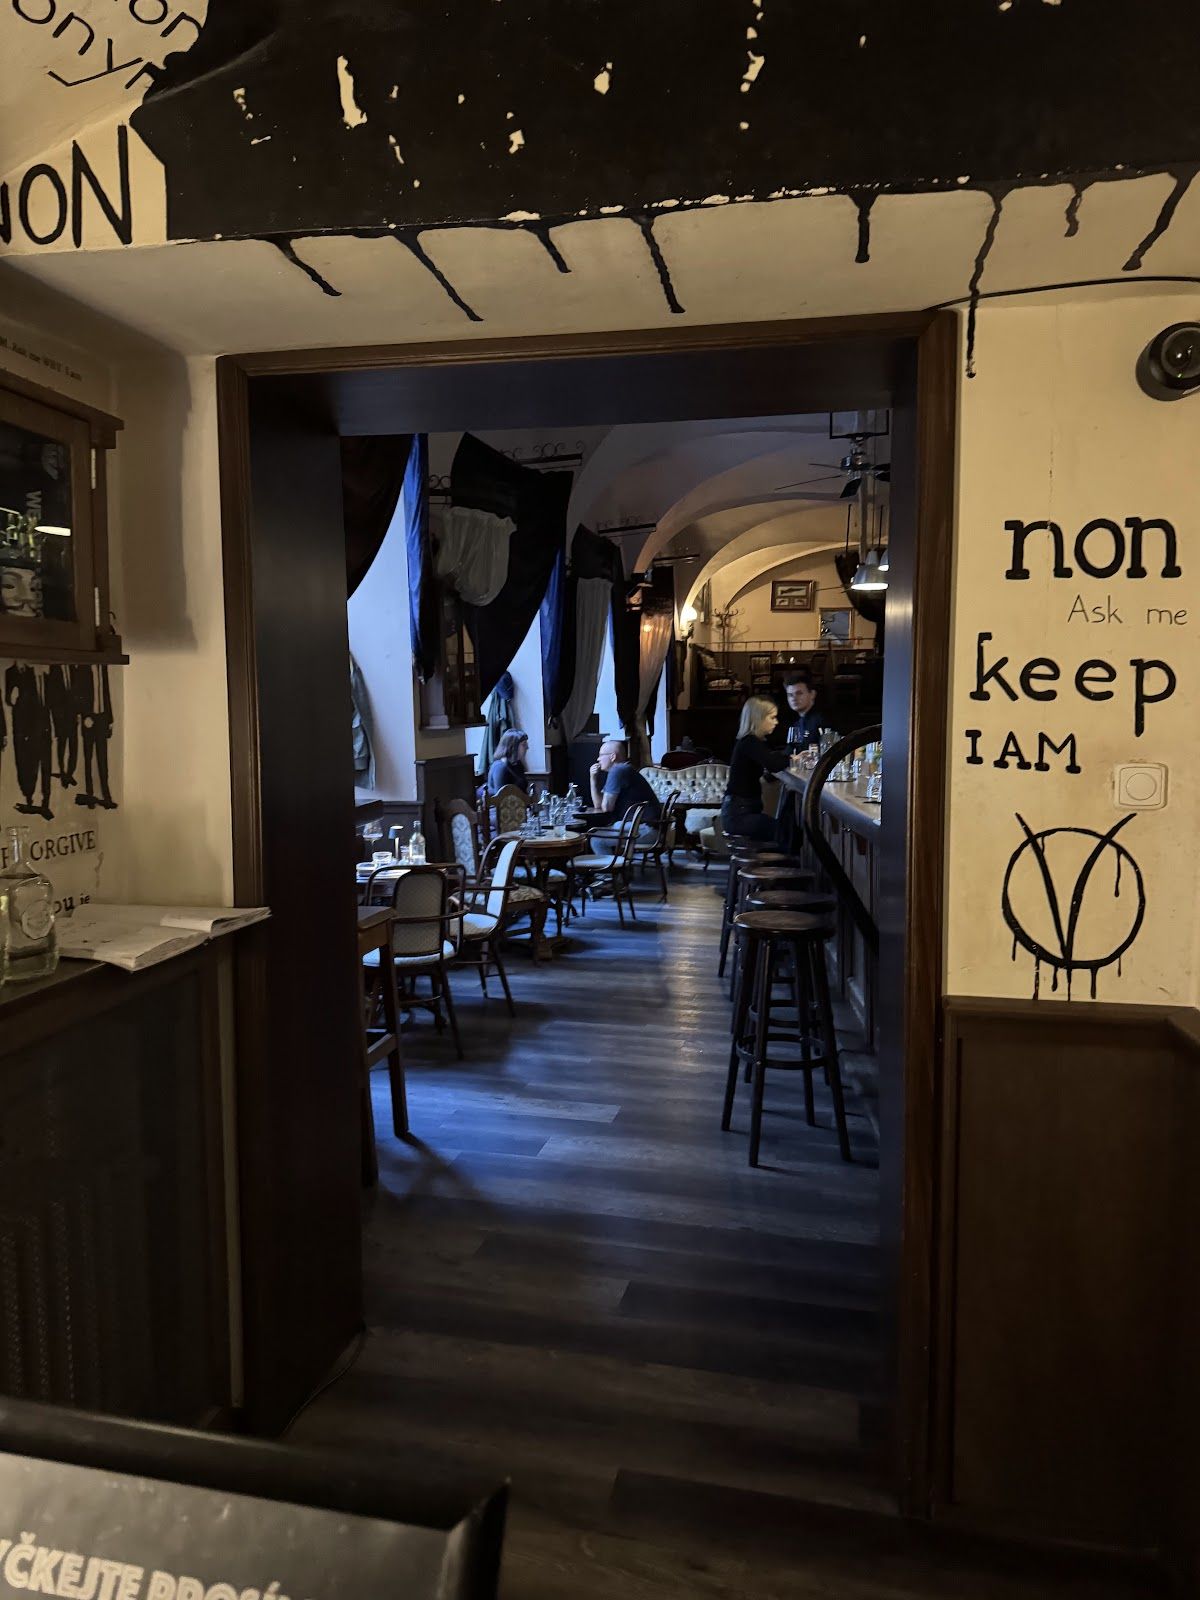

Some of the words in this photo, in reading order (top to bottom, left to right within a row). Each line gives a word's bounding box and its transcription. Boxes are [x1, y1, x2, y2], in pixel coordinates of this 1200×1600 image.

[1004, 516, 1182, 580] non
[1067, 594, 1123, 624] Ask
[1146, 607, 1188, 626] me
[969, 631, 1177, 738] keep
